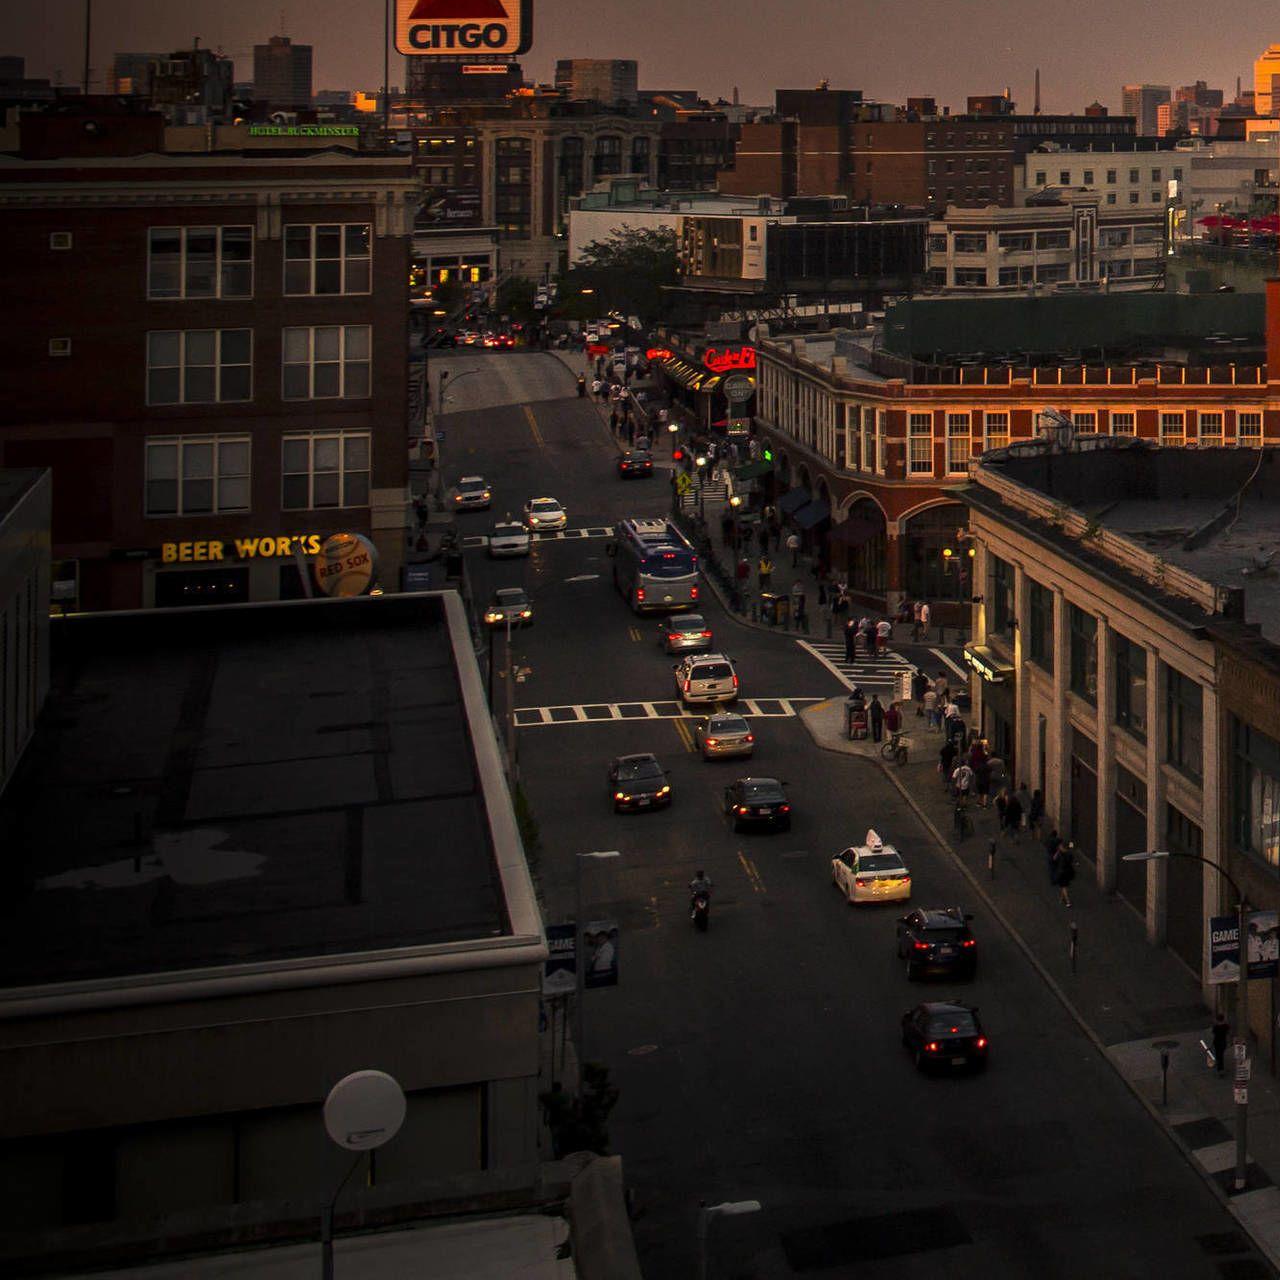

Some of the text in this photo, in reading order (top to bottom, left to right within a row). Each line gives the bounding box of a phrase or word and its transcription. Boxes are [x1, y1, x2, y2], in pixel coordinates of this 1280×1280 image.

[408, 23, 507, 49] CITGO
[249, 126, 283, 136] HOTEL
[161, 539, 225, 564] BEER
[319, 552, 370, 578] RED SOX
[1212, 928, 1240, 943] GAME
